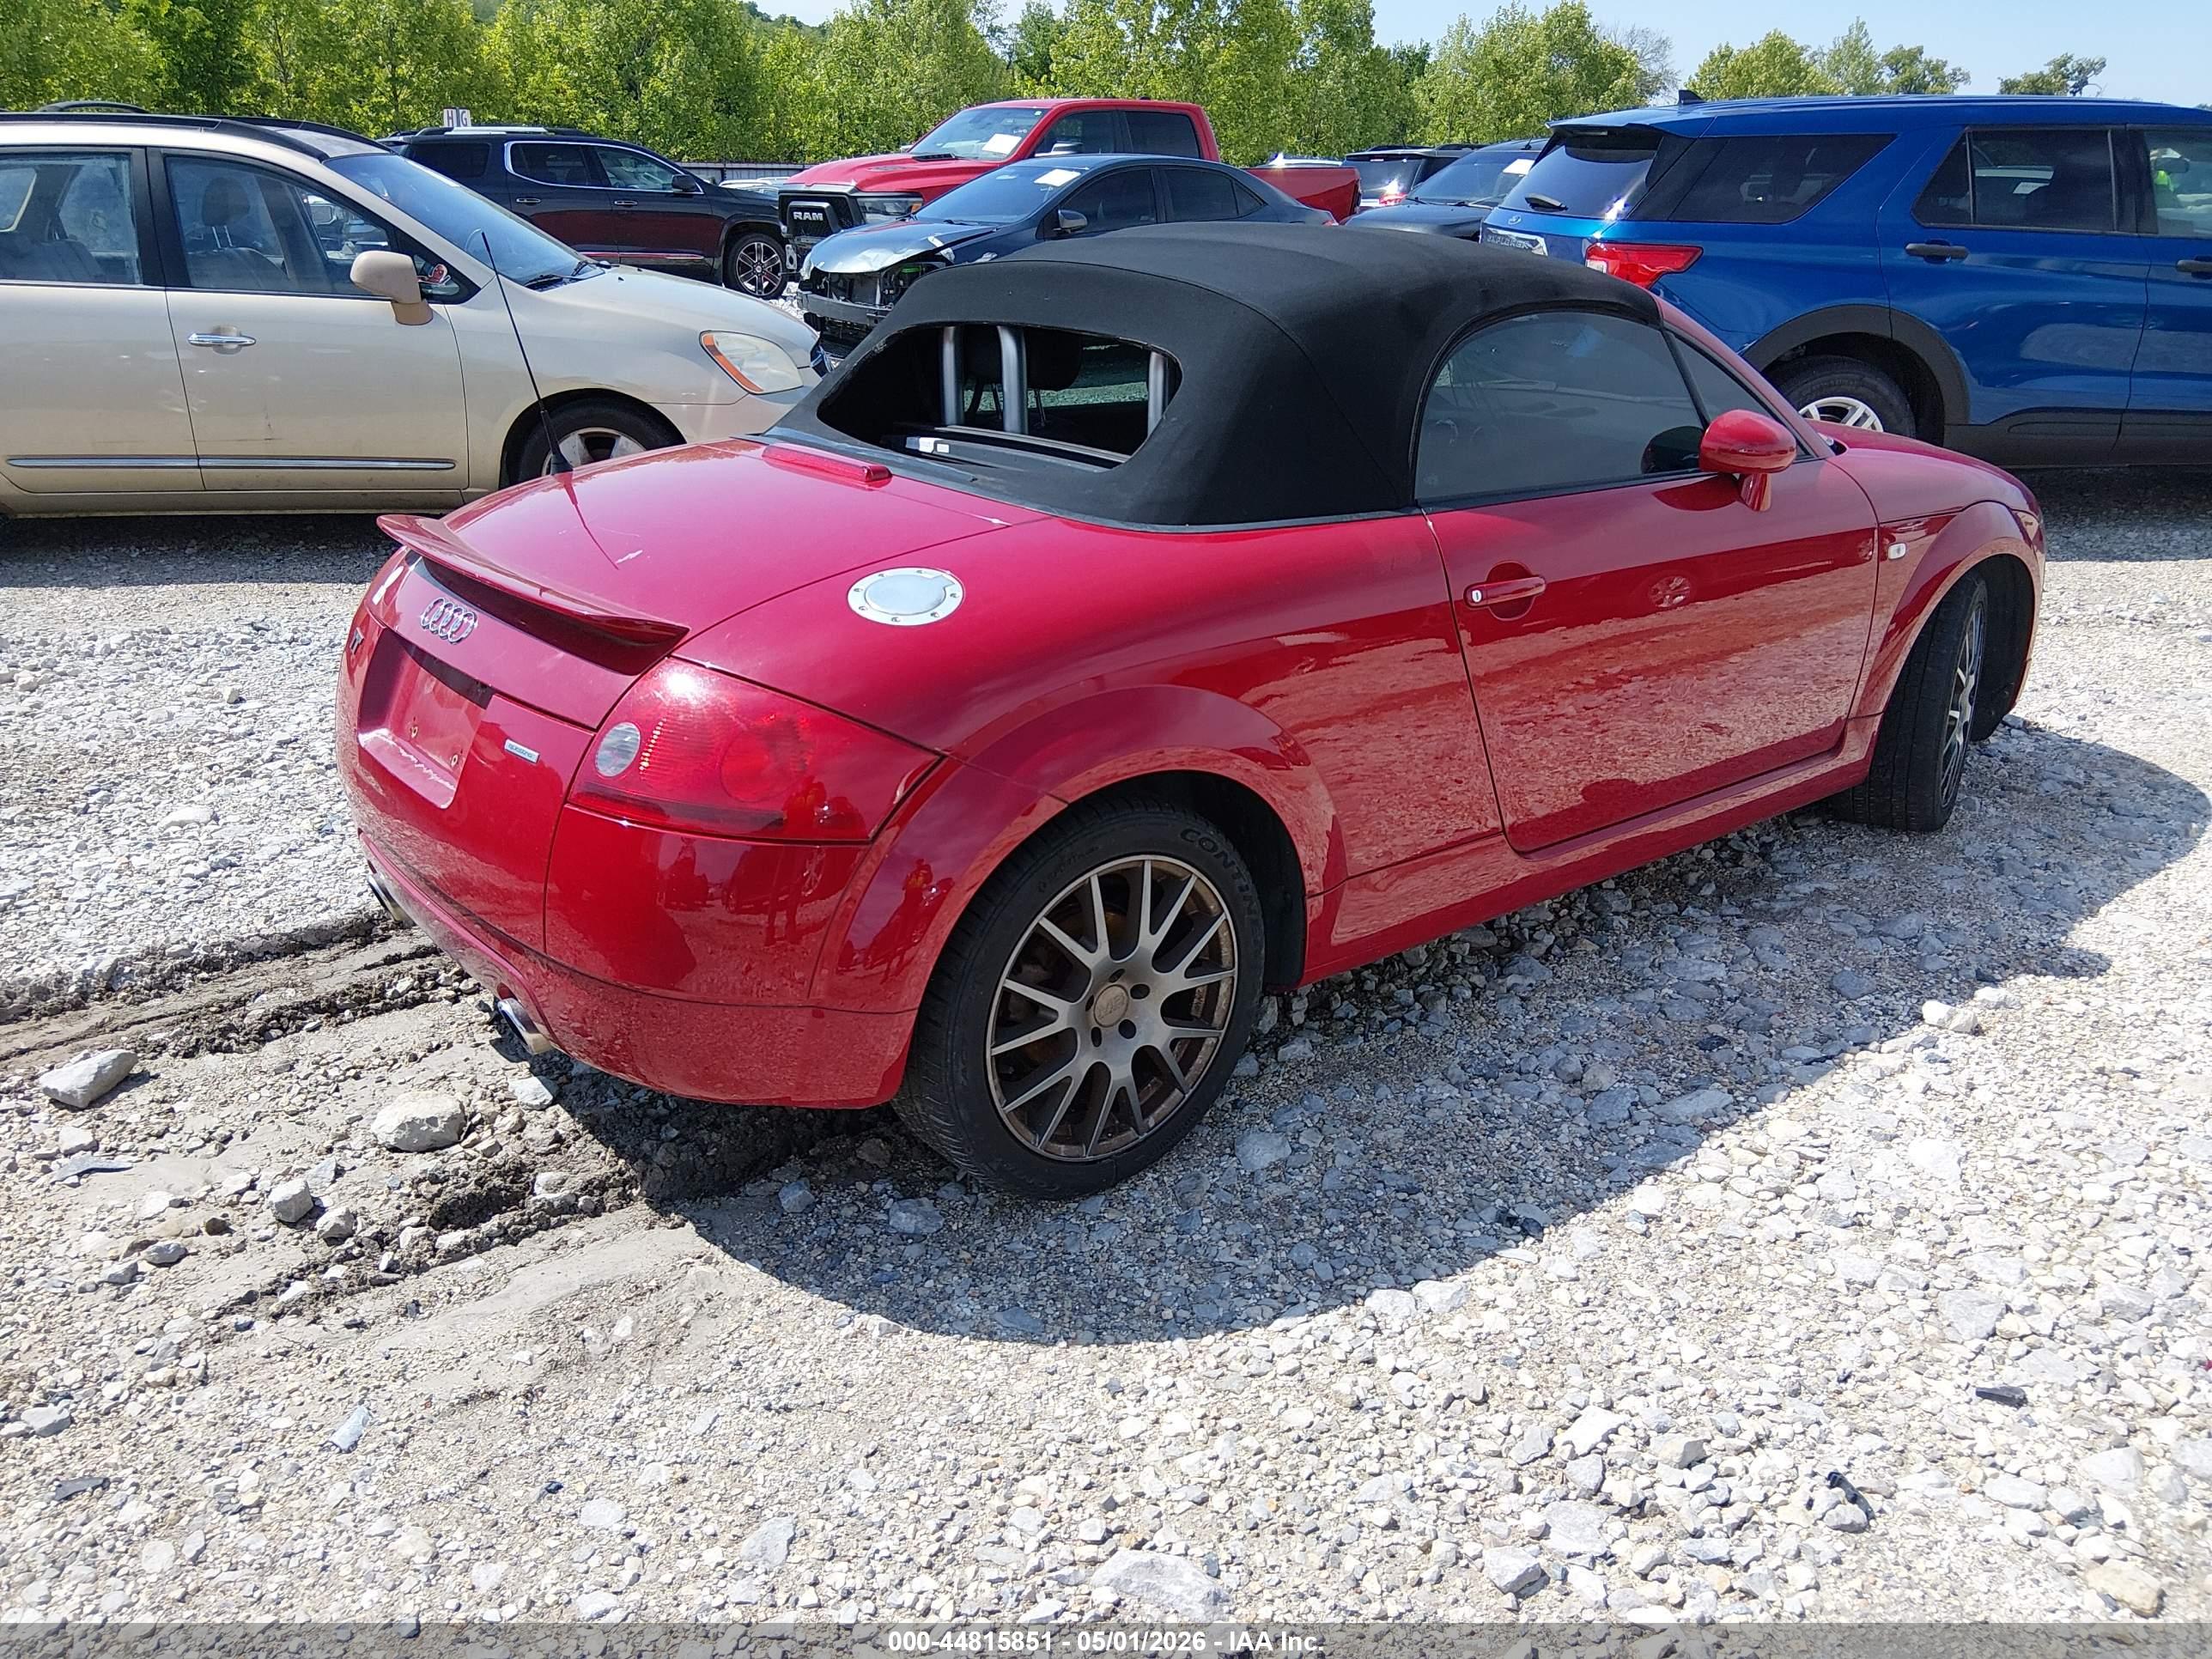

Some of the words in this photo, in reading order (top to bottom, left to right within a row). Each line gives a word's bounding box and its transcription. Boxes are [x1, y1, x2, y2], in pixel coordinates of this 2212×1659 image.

[447, 109, 454, 127] H
[461, 111, 468, 127] G
[793, 211, 823, 222] RAM
